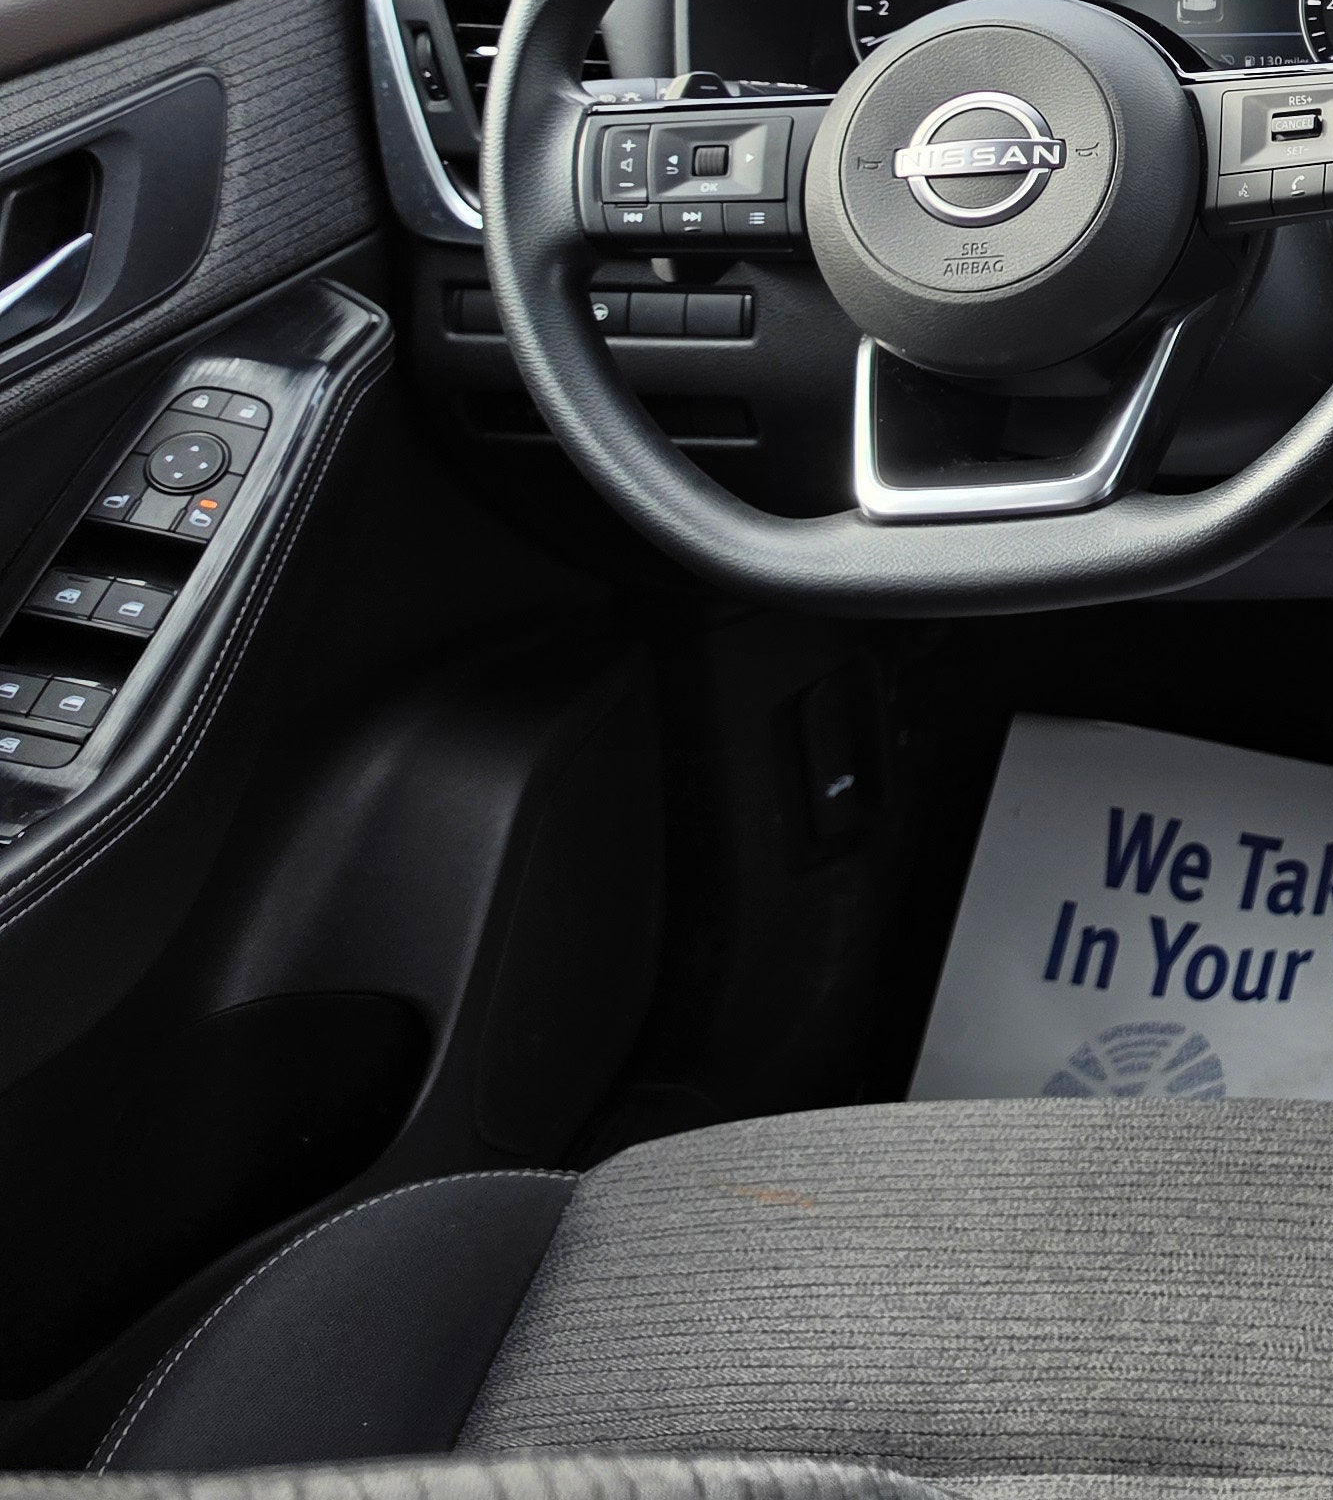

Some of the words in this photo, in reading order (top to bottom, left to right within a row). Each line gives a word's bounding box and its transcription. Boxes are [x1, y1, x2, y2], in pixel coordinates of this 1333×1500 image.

[879, 0, 890, 15] 2
[1260, 55, 1282, 66] 130
[1288, 95, 1313, 106] RES+
[1275, 117, 1314, 130] CANCEL
[900, 145, 1061, 169] NISSAN
[700, 182, 719, 193] OK
[961, 242, 989, 257] SRS
[943, 259, 1005, 277] AIRBAG
[1102, 806, 1212, 904] We
[1043, 900, 1121, 990] In
[1147, 914, 1313, 1003] Your
